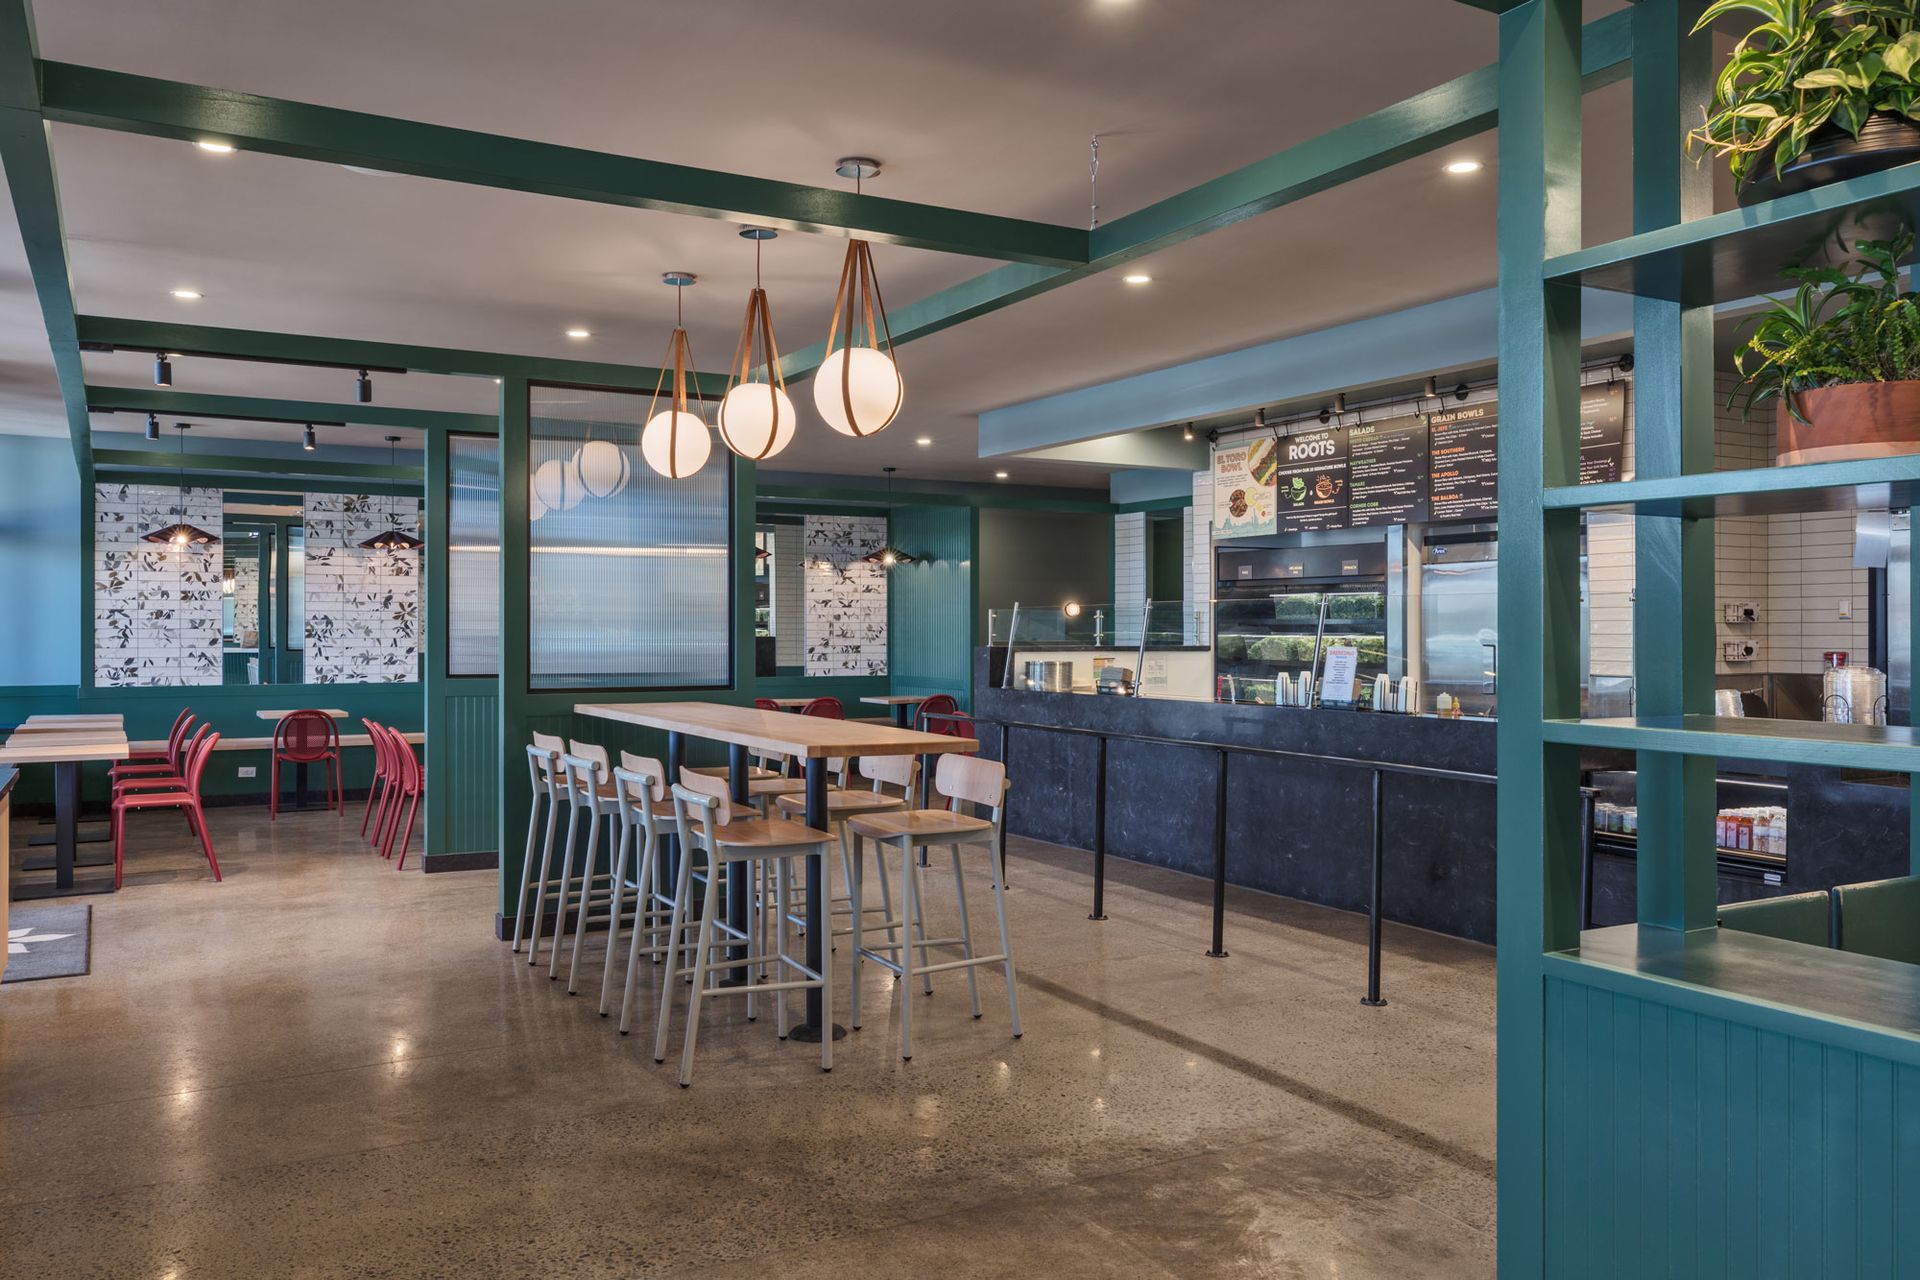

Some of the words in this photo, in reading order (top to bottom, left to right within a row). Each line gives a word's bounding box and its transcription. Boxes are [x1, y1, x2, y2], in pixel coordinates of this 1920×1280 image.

[1431, 413, 1456, 424] GRAIN
[1457, 408, 1485, 420] BOWLS
[1349, 426, 1375, 436] SALADS
[1295, 434, 1320, 444] WELCOME
[1320, 432, 1329, 440] TO
[1288, 439, 1336, 460] ROOTS
[1441, 446, 1465, 455] SOUTHERN
[1216, 454, 1226, 465] EL
[1226, 451, 1247, 463] TORO
[1220, 462, 1243, 474] BOWL
[1440, 470, 1459, 478] APOLLO
